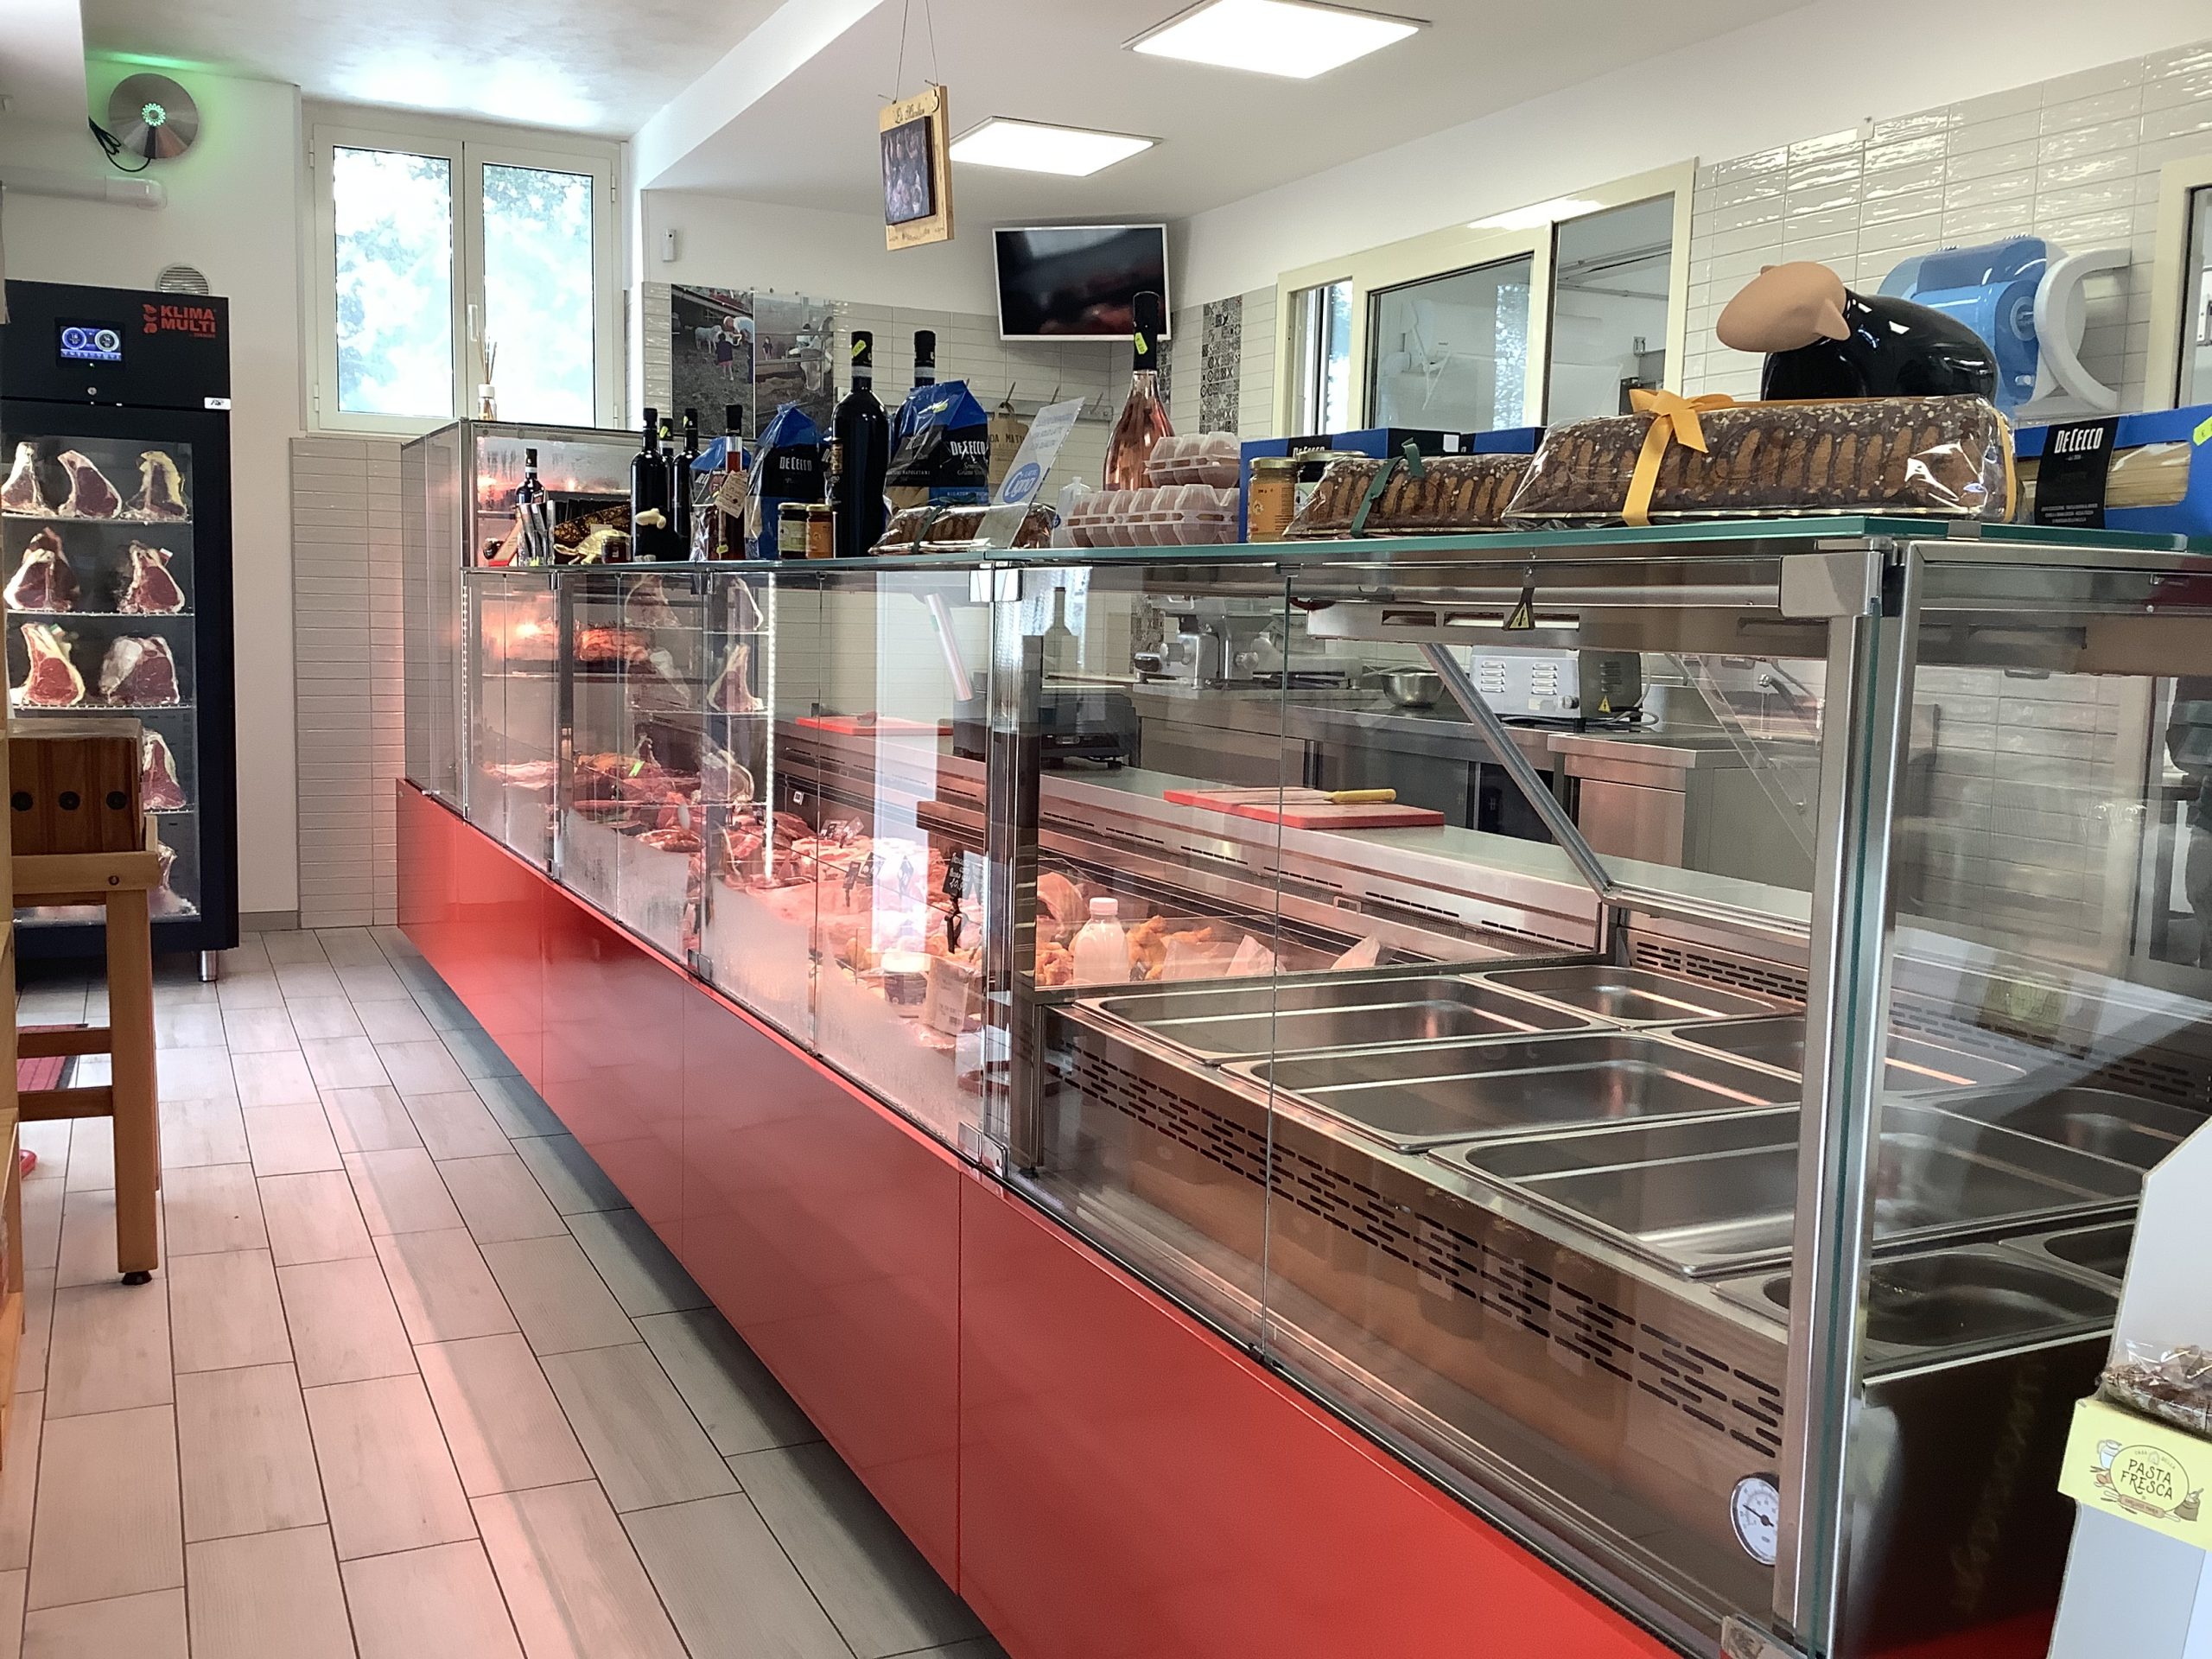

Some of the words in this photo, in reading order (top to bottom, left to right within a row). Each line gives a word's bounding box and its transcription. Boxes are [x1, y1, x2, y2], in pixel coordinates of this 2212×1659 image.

[161, 305, 215, 321] KLIMA
[161, 317, 216, 333] MULTI
[2128, 1459, 2171, 1485] PASTA
[2120, 1470, 2173, 1501] FRESCA
